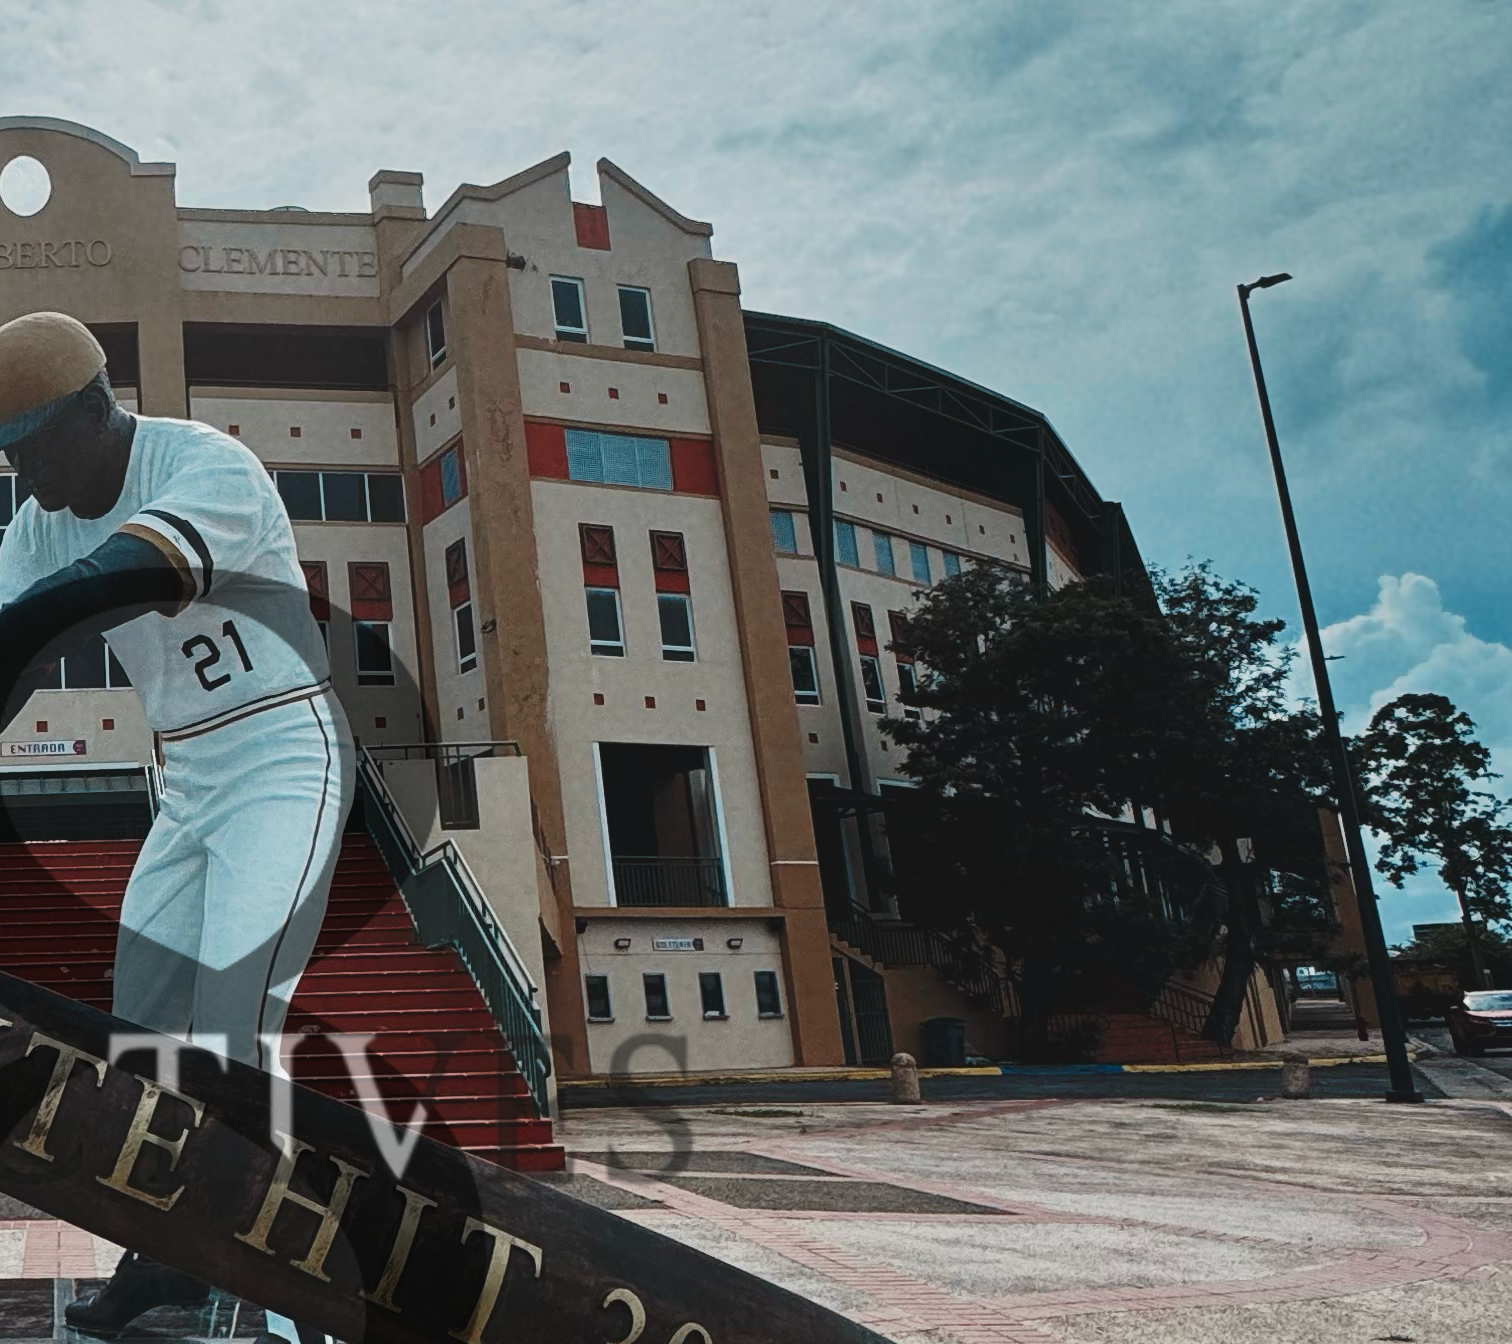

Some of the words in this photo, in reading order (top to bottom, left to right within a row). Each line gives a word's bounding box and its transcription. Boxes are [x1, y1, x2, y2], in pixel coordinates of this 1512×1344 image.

[178, 244, 378, 279] CLEMENTE
[181, 620, 253, 691] 21
[10, 742, 65, 755] ENTRADA
